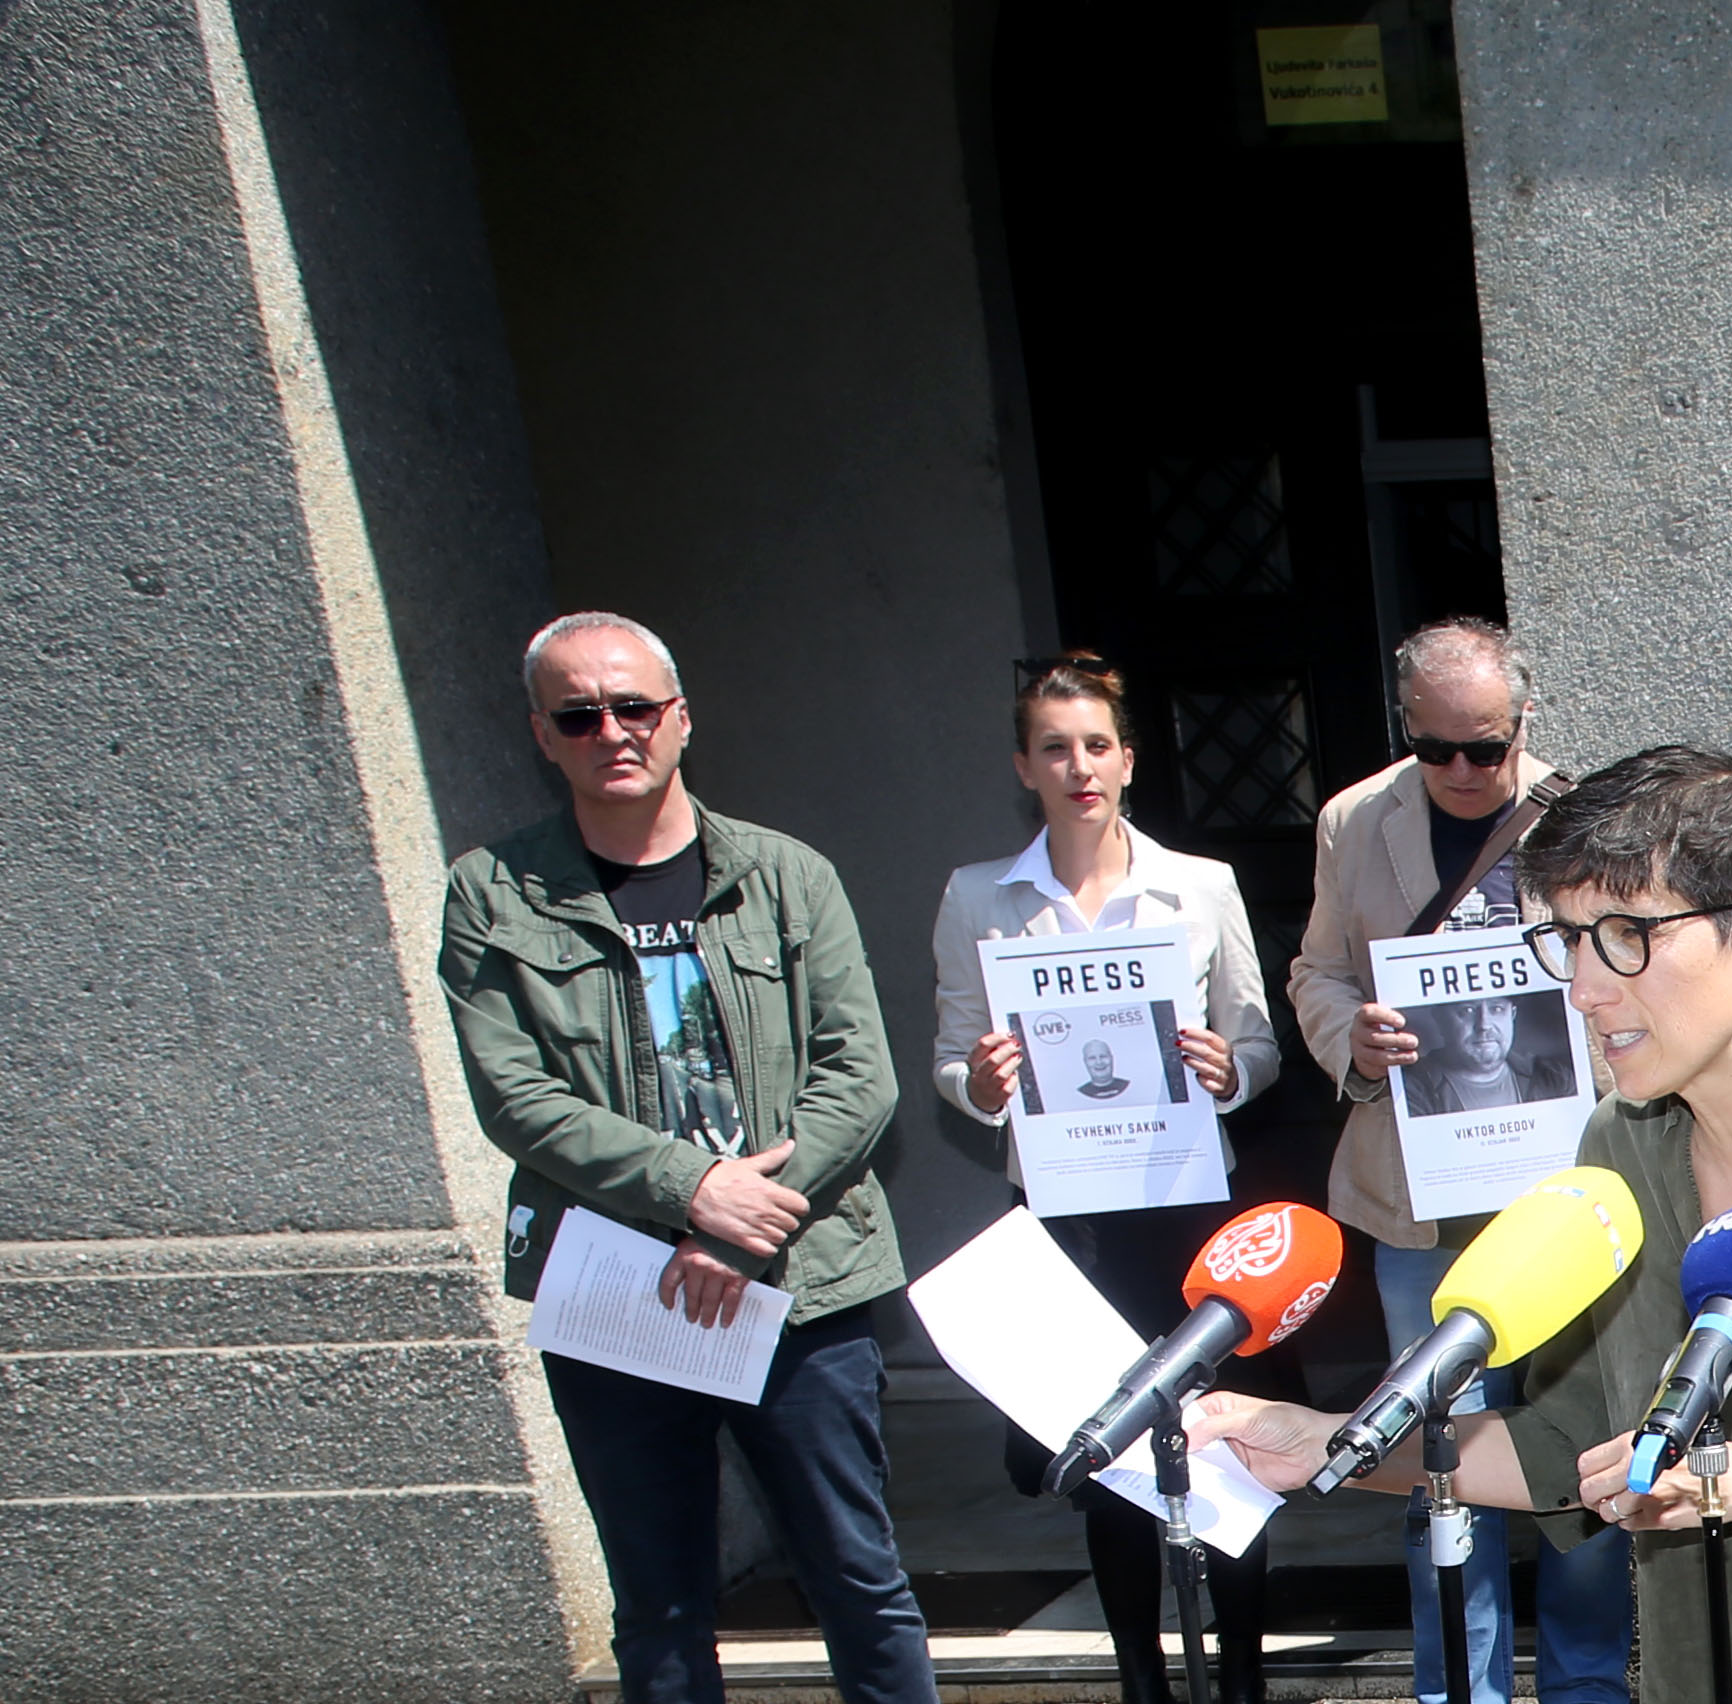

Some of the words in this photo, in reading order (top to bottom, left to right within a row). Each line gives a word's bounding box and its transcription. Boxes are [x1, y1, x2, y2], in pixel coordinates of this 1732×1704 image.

[621, 919, 695, 949] BEAT
[1032, 960, 1145, 996] PRESS
[1419, 958, 1529, 997] PRESS
[1099, 1010, 1143, 1027] PRESS
[1066, 1122, 1123, 1139] YEVHENIY
[1128, 1120, 1167, 1135] SAKUN
[1454, 1123, 1495, 1140] VIKTOR
[1500, 1119, 1536, 1135] DEDOV
